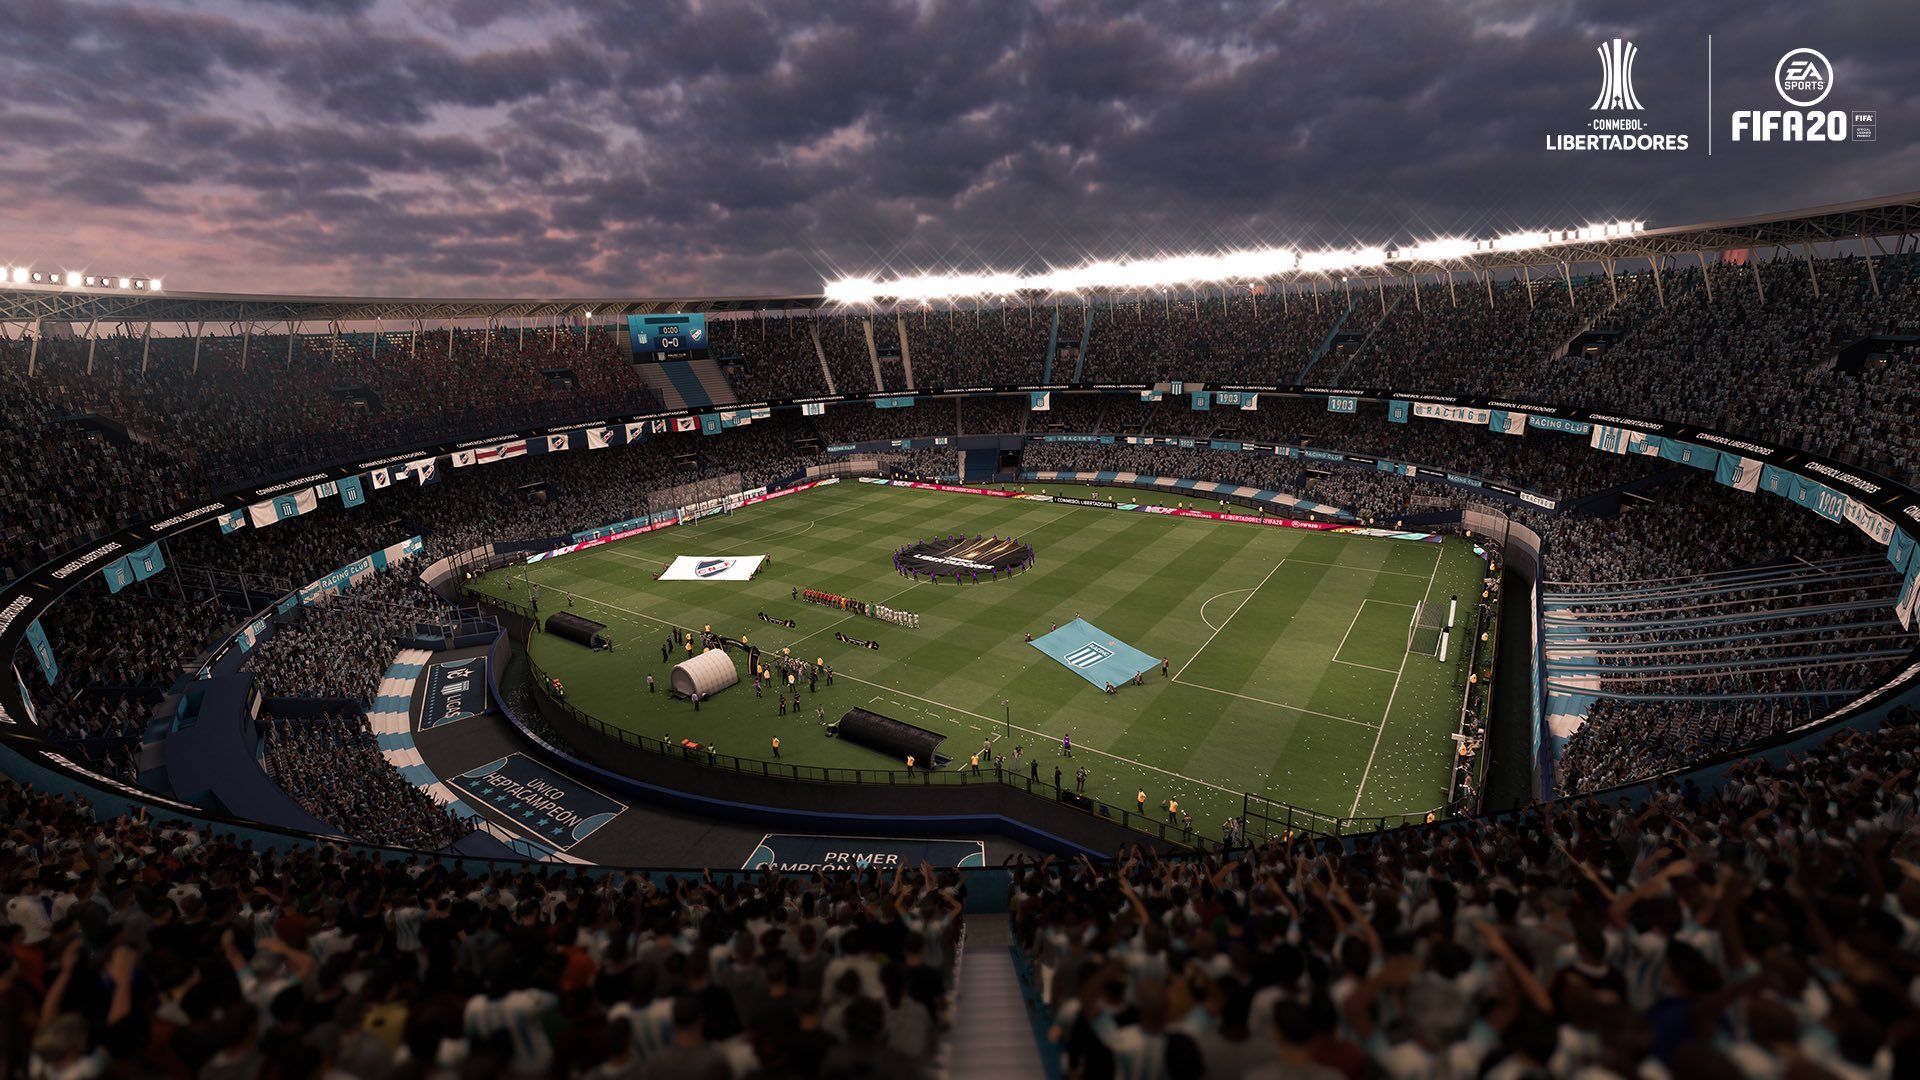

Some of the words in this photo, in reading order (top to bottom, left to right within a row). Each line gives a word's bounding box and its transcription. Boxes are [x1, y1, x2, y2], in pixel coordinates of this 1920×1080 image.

[663, 326, 679, 334] 0:00
[662, 337, 679, 348] 0-0
[1219, 393, 1238, 403] 1903
[1331, 399, 1353, 411] 1903
[1426, 406, 1474, 420] RACING
[1530, 417, 1562, 429] RACING
[1564, 422, 1589, 433] CLUB
[1818, 491, 1842, 518] 1903
[321, 569, 349, 589] RACING
[350, 560, 369, 574] CLUB
[445, 693, 462, 718] LIGAS
[526, 777, 565, 800] ÚNICO
[482, 772, 583, 827] HEPTACAMPEÓN
